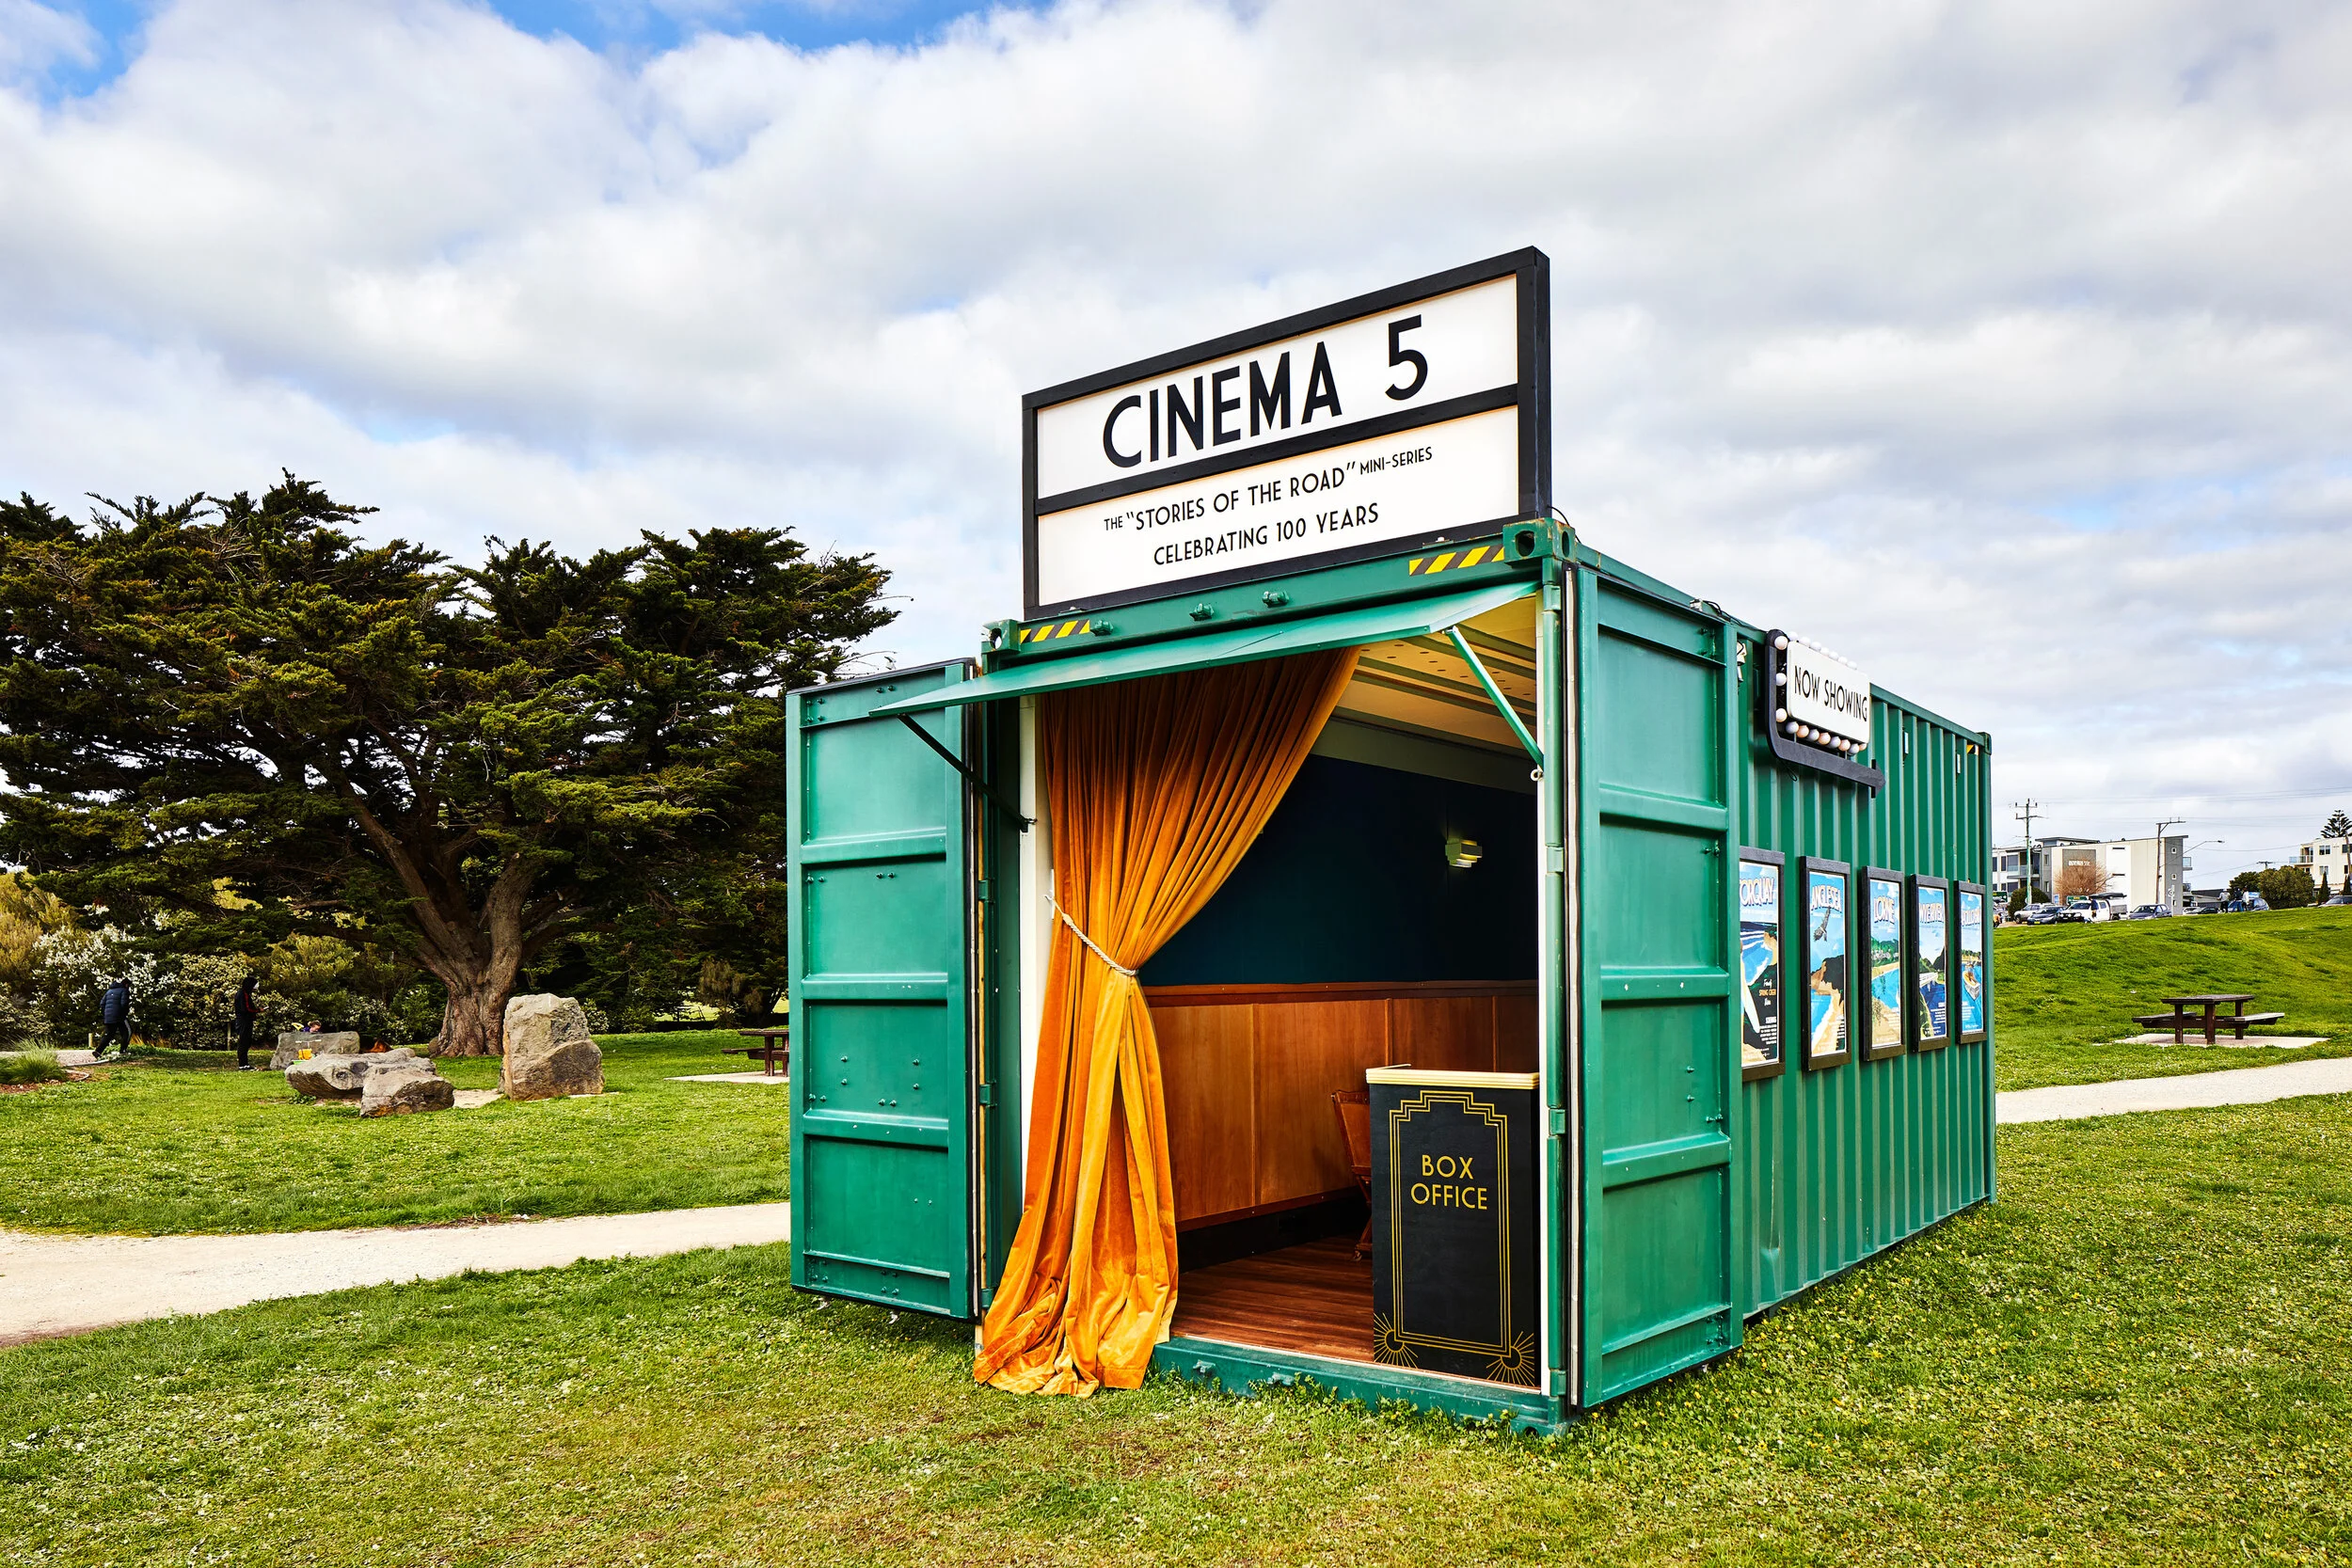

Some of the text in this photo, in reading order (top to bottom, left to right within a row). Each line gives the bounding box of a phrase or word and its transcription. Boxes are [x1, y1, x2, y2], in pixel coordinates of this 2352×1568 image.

[1103, 313, 1428, 468] CINEMA 5
[1104, 516, 1123, 531] THE
[1213, 489, 1239, 514] OF
[1248, 480, 1281, 506] THE
[1359, 446, 1433, 475] MINI-SERIES
[1153, 502, 1379, 566] CELEBRATING 100 YEARS
[1794, 664, 1868, 722] NOW SHOWING
[1811, 884, 1842, 913] ANGLESEA
[1873, 895, 1896, 925] LORNE
[1422, 1154, 1474, 1180] BOX
[1410, 1182, 1487, 1211] OFFICE
